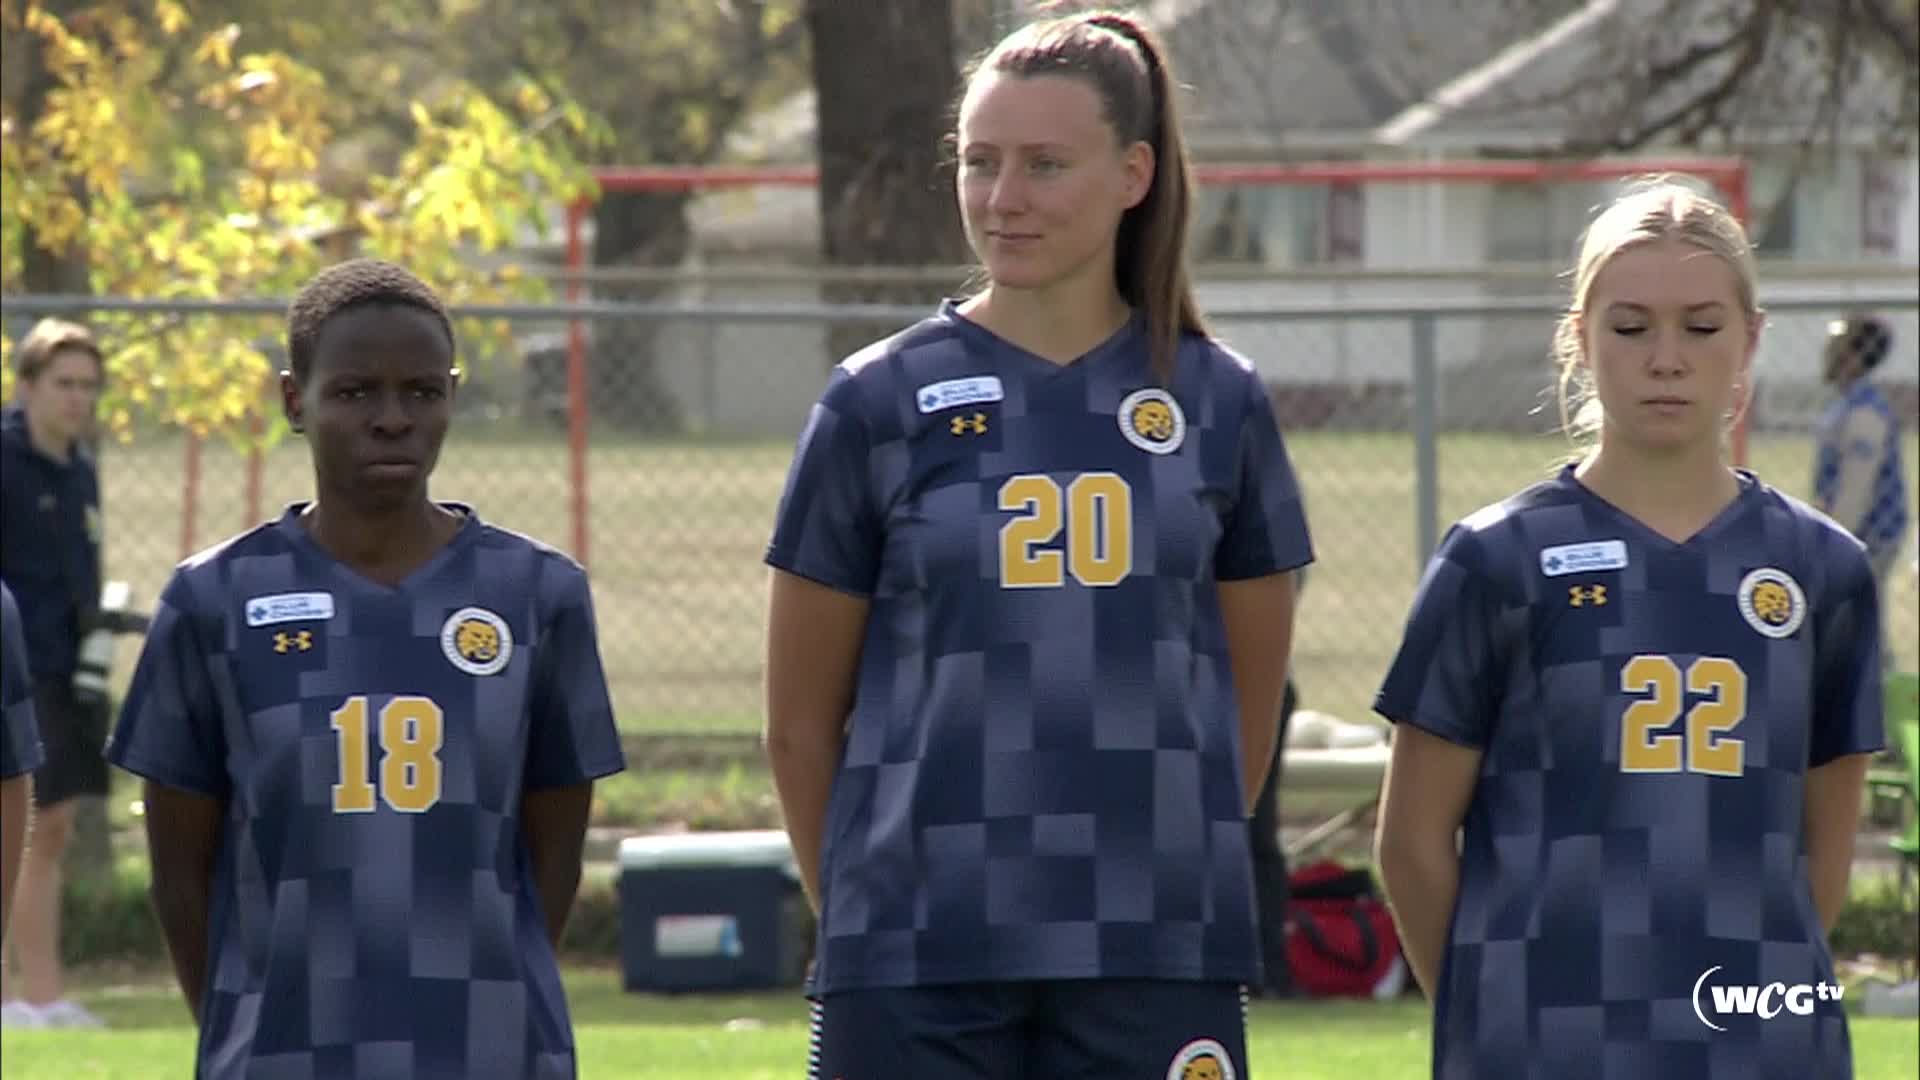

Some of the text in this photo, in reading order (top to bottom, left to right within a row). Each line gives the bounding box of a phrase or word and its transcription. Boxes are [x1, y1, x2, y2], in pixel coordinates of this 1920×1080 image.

[997, 472, 1133, 588] 20
[330, 696, 443, 813] 18
[1620, 655, 1747, 777] 22
